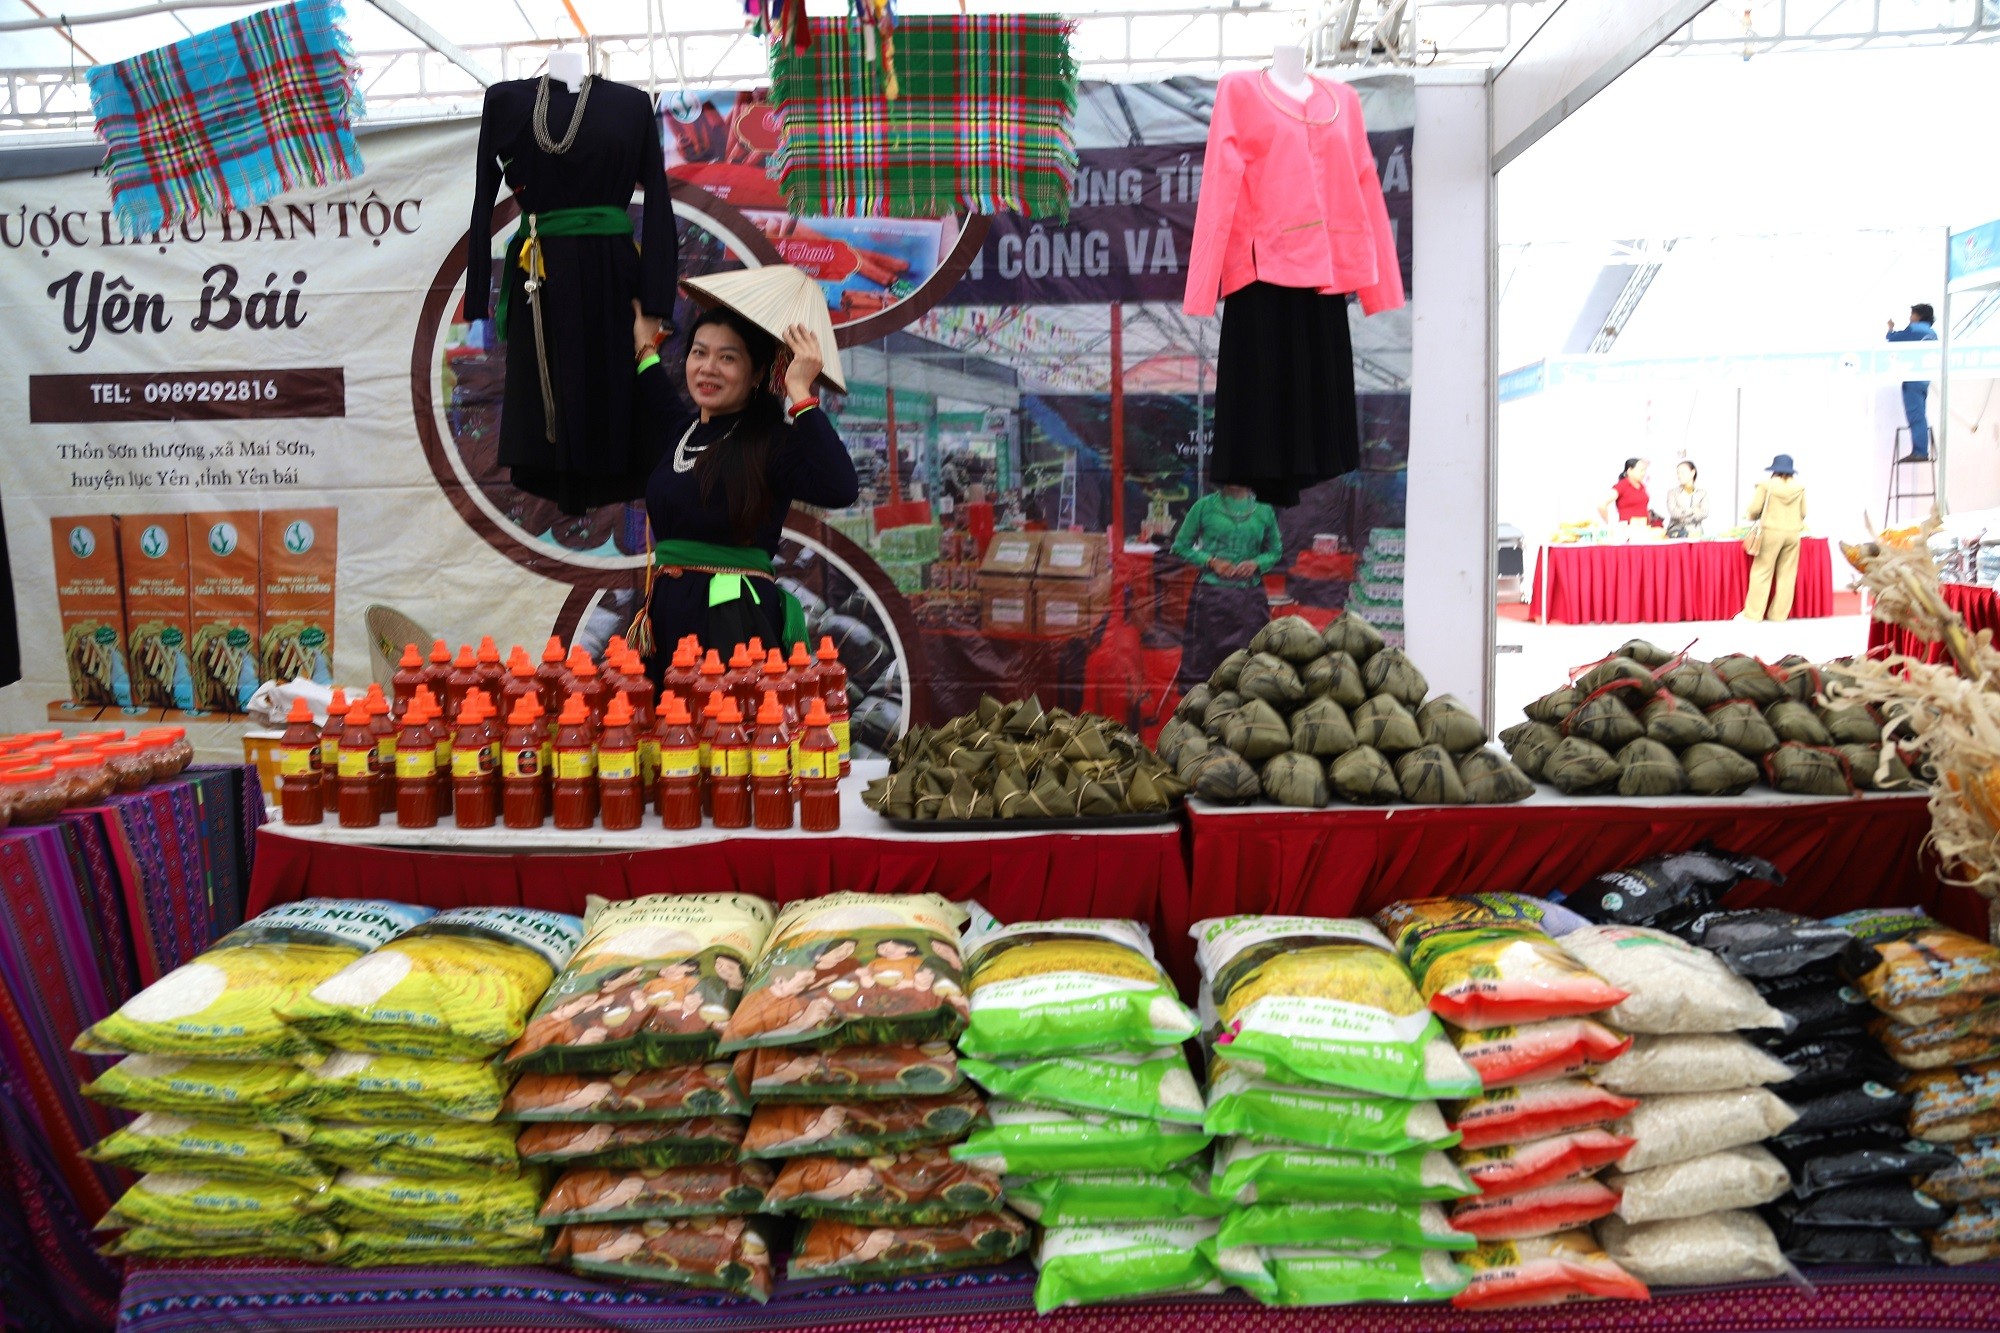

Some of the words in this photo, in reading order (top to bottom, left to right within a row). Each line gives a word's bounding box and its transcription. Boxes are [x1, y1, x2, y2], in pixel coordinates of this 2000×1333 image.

[327, 189, 423, 248] TỘC
[999, 223, 1110, 280] CÔNG
[1123, 219, 1179, 275] VÀ
[47, 270, 173, 353] Yên
[190, 263, 308, 332] Bái
[90, 383, 132, 404] TEL:
[143, 378, 278, 403] 0989292816
[56, 441, 104, 459] Thôn
[107, 442, 137, 459] Sơn
[141, 442, 206, 460] thượng
[239, 440, 271, 457] Mai
[275, 440, 316, 457] Sơn,
[71, 468, 125, 490] huyện
[128, 469, 153, 489] lục
[156, 468, 190, 487] Yên
[236, 467, 269, 485] Yên
[272, 466, 299, 485] bái
[1372, 1044, 1382, 1060] 5
